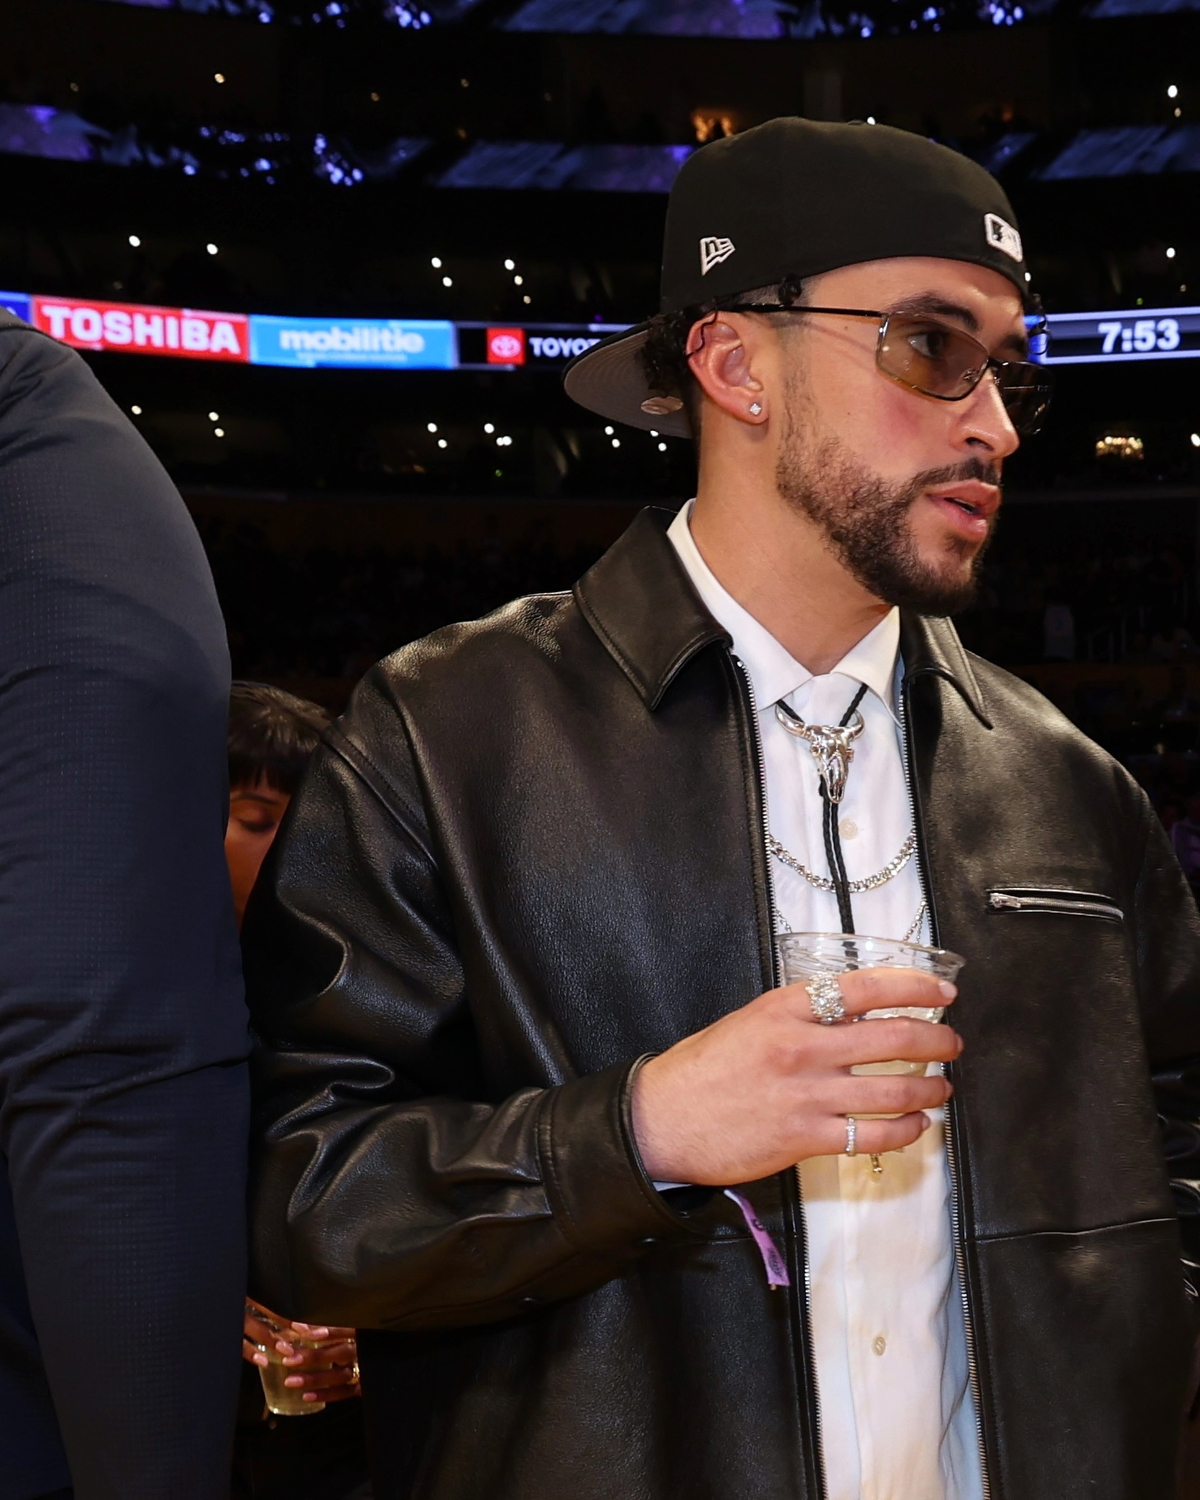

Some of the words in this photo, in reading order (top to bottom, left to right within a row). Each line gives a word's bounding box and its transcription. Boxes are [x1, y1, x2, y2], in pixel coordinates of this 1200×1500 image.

[40, 304, 242, 355] TOSHIBA
[279, 326, 426, 354] mobilitie
[1098, 319, 1181, 354] 7:53
